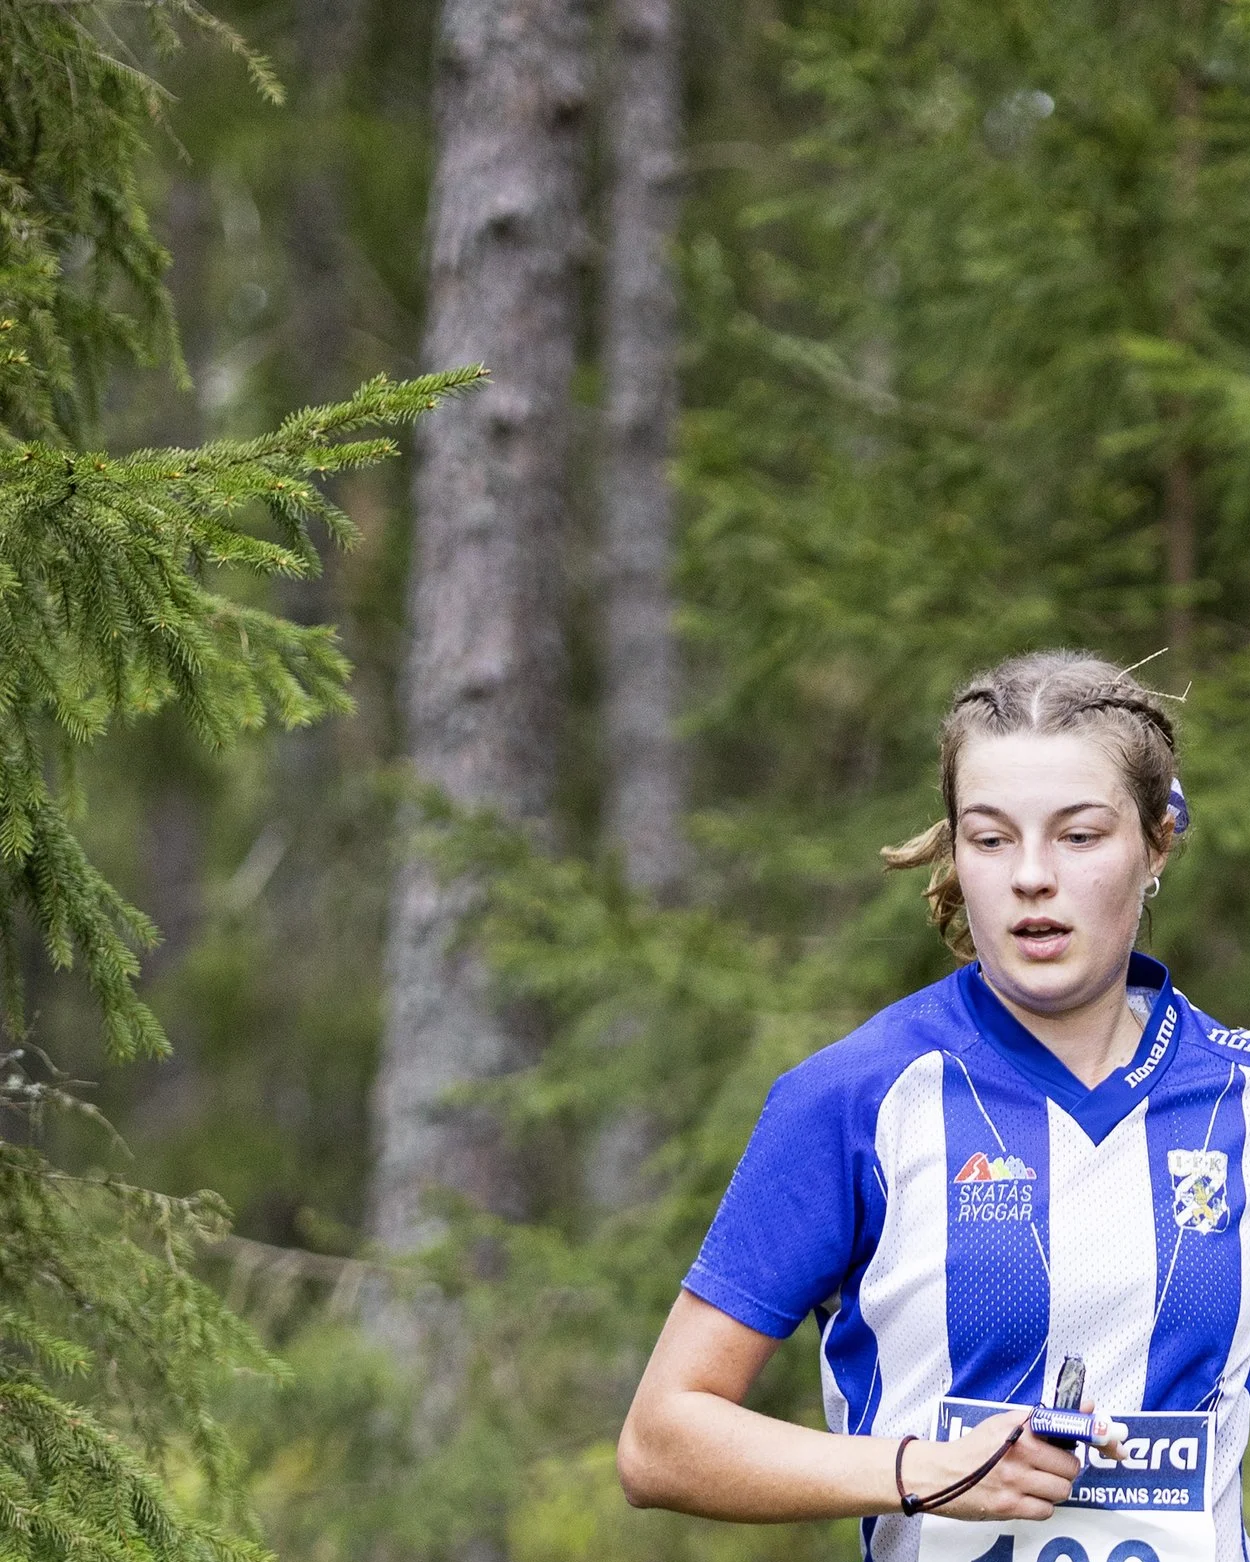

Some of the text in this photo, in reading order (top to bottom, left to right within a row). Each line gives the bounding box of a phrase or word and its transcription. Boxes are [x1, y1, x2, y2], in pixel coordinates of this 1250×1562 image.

[1124, 1004, 1178, 1089] noname
[958, 1179, 1033, 1203] SKATÅS
[958, 1203, 1033, 1222] RYGGAR
[1068, 1486, 1190, 1505] LDISTANS 2025
